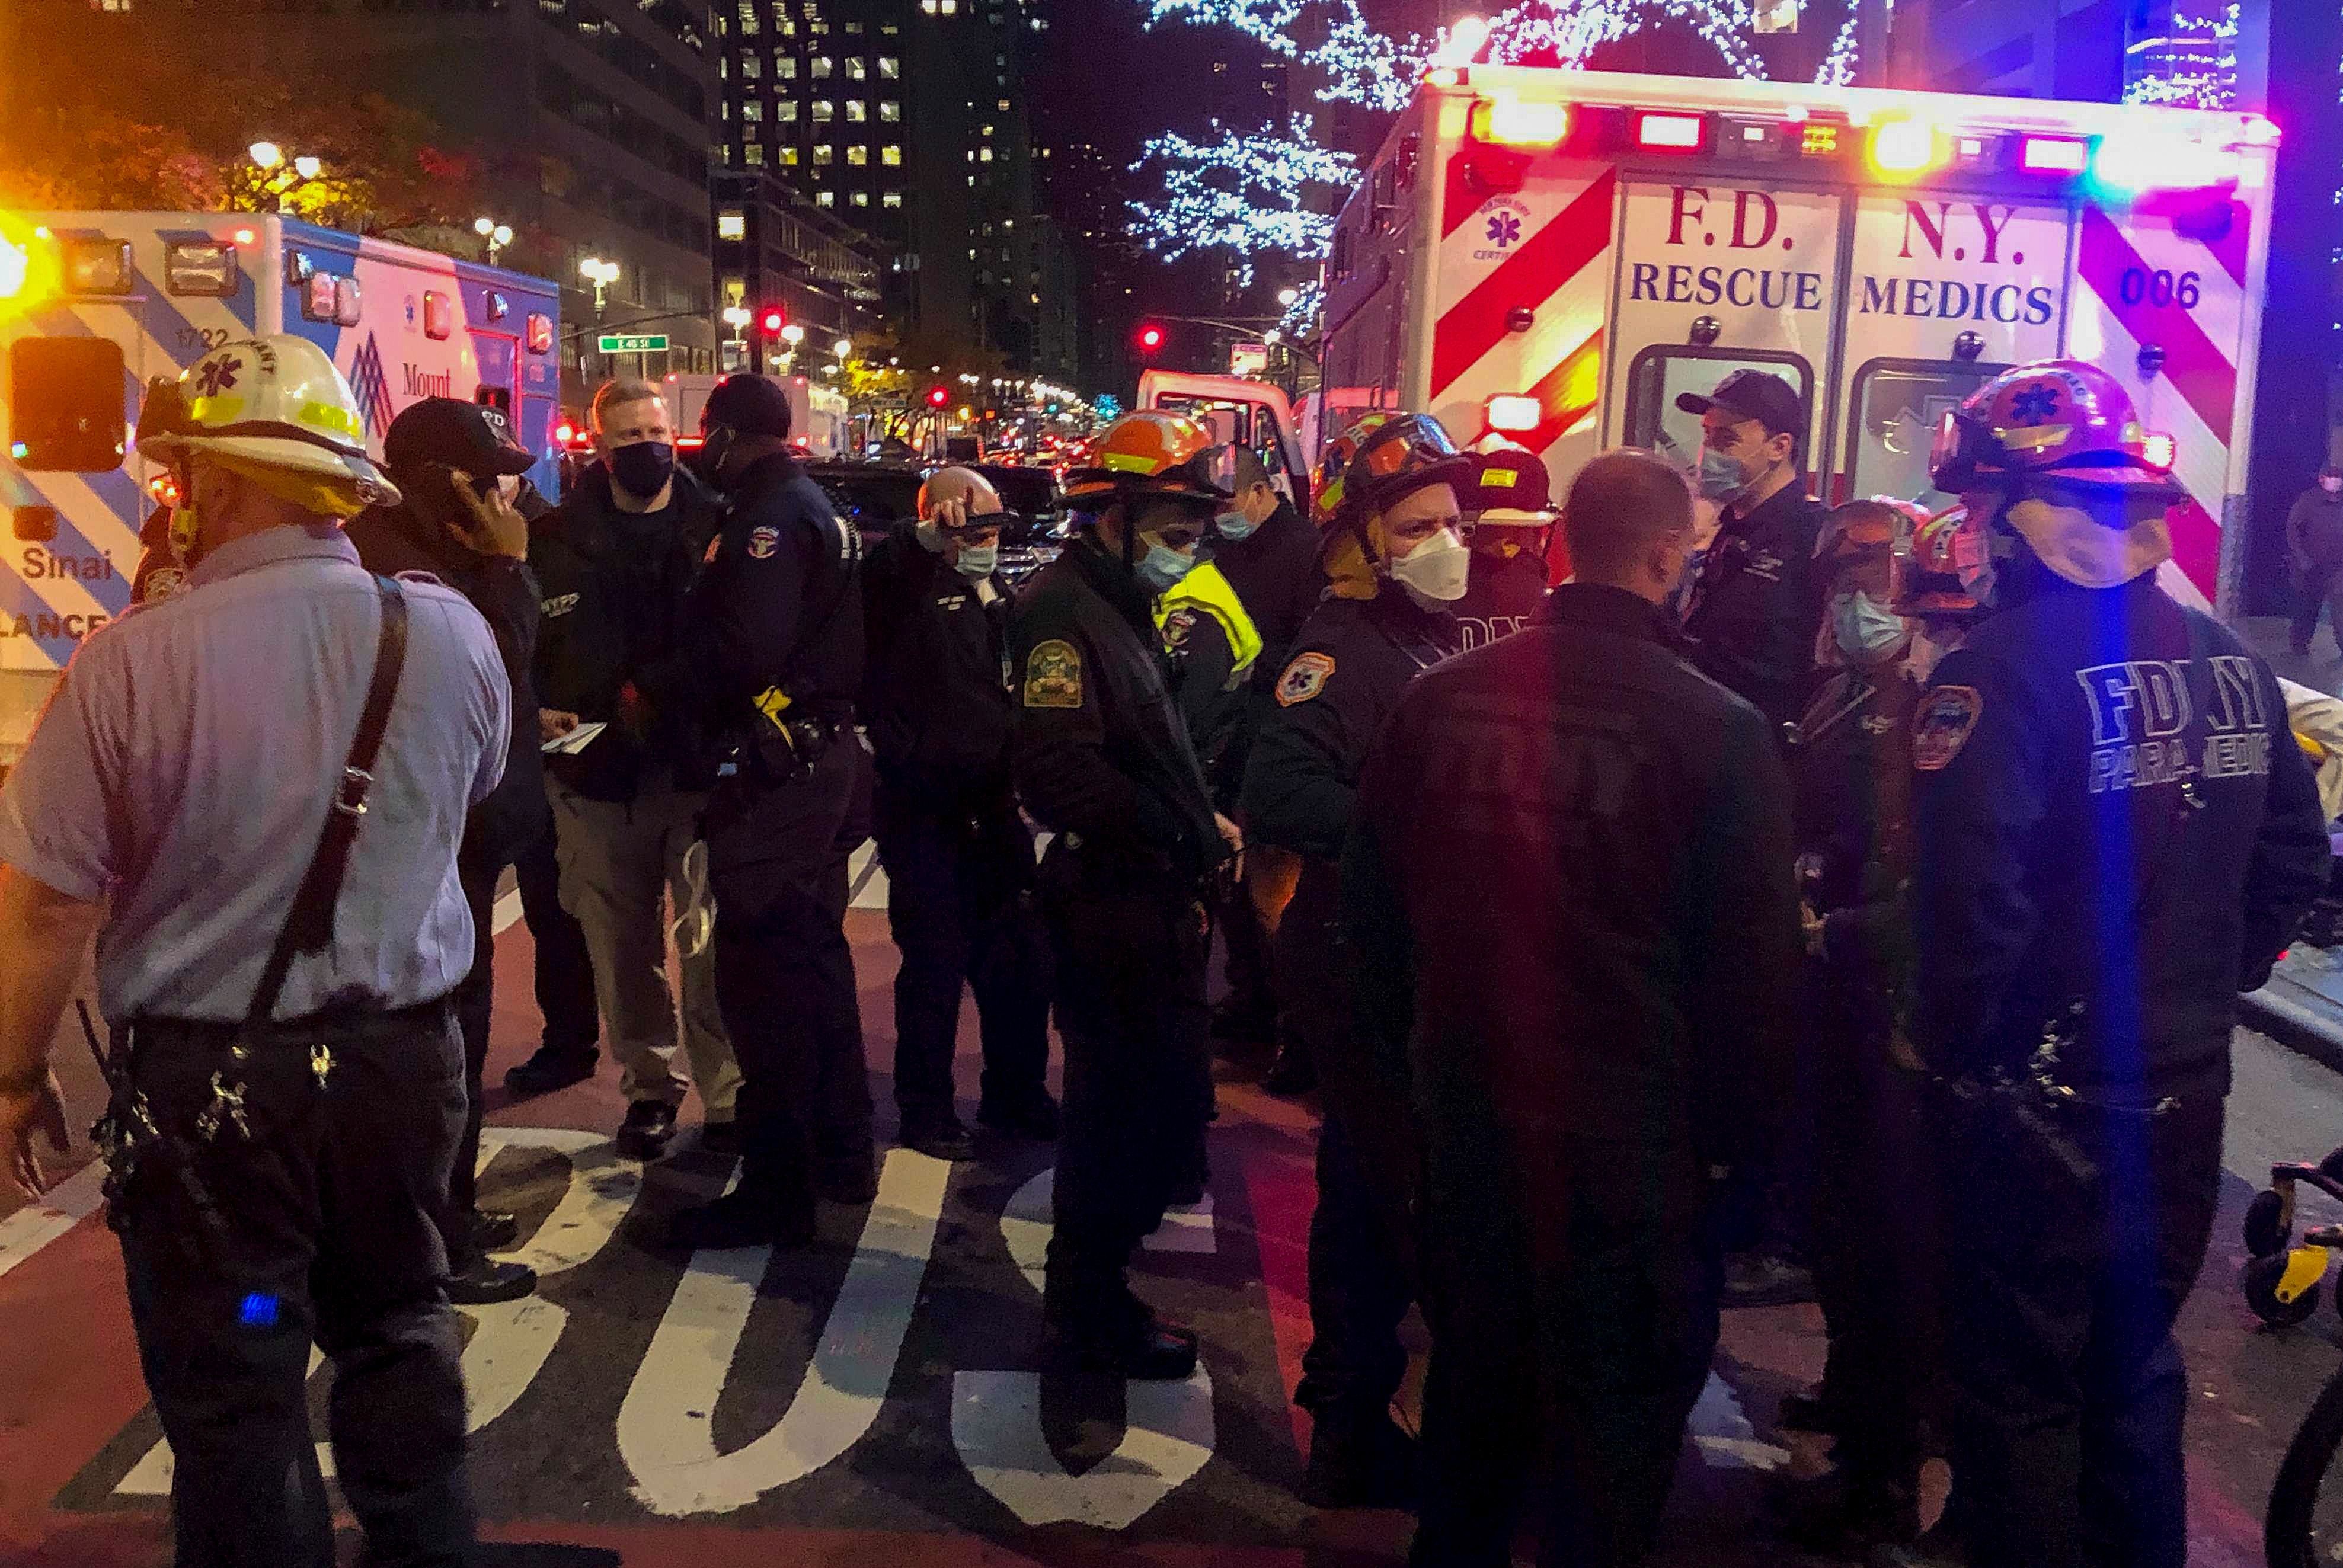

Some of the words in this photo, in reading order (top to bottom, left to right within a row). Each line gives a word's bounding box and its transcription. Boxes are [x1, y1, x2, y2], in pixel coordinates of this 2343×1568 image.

[1666, 186, 1792, 251] F.D.
[1898, 200, 2024, 265] N.Y.
[1630, 263, 1822, 310] RESCUE
[1859, 275, 2053, 325] MEDICS
[2120, 268, 2201, 309] 006
[403, 362, 452, 398] Mount
[22, 548, 112, 579] Sinai
[2088, 732, 2271, 795] PARAEDIC
